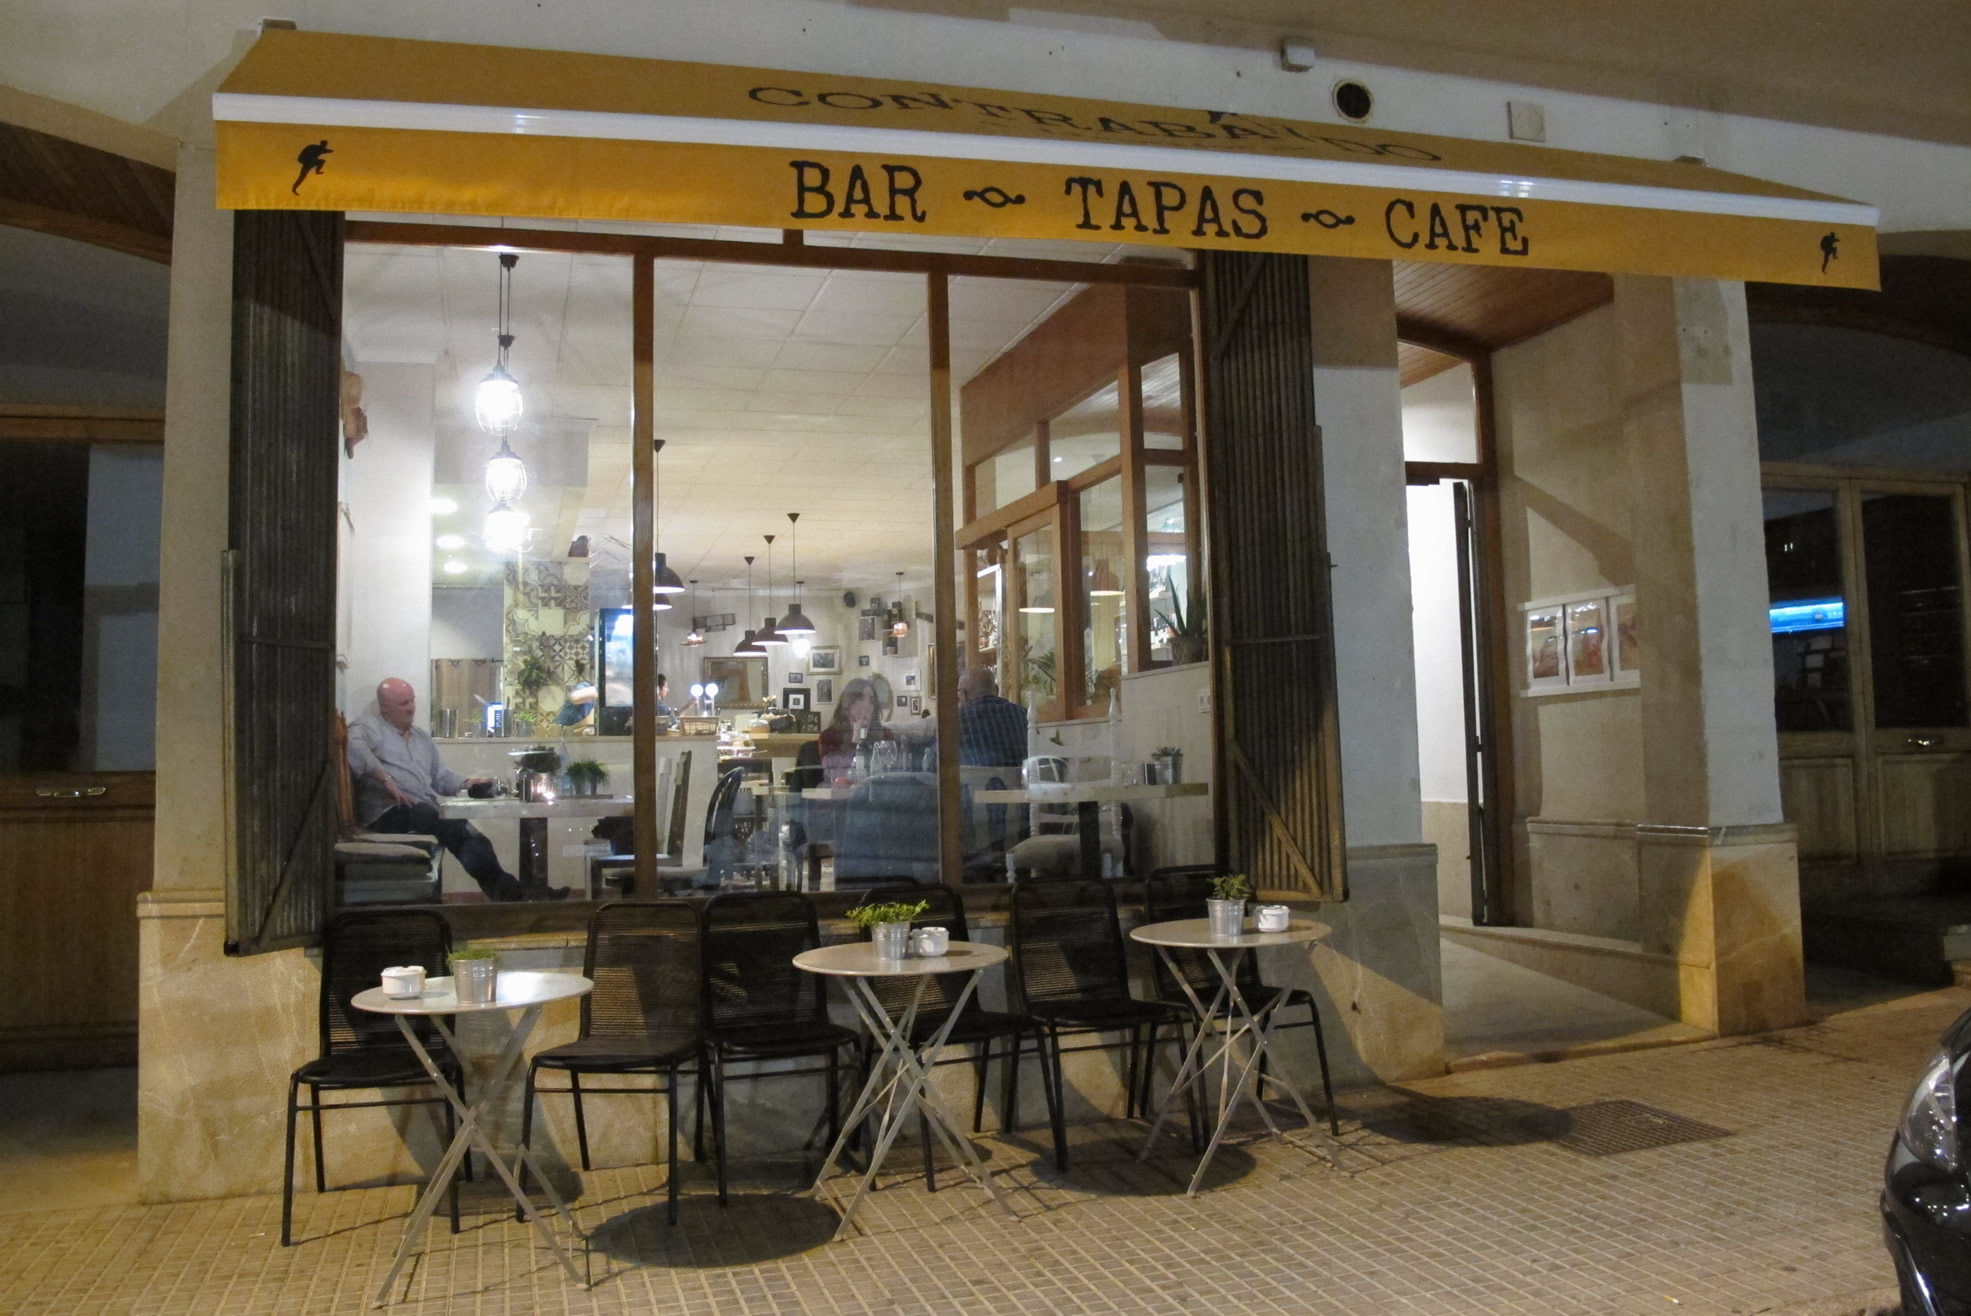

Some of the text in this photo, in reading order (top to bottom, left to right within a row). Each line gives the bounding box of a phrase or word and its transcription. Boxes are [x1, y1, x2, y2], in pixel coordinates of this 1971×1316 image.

[789, 160, 1529, 256] BAR TAPAS CAFE
